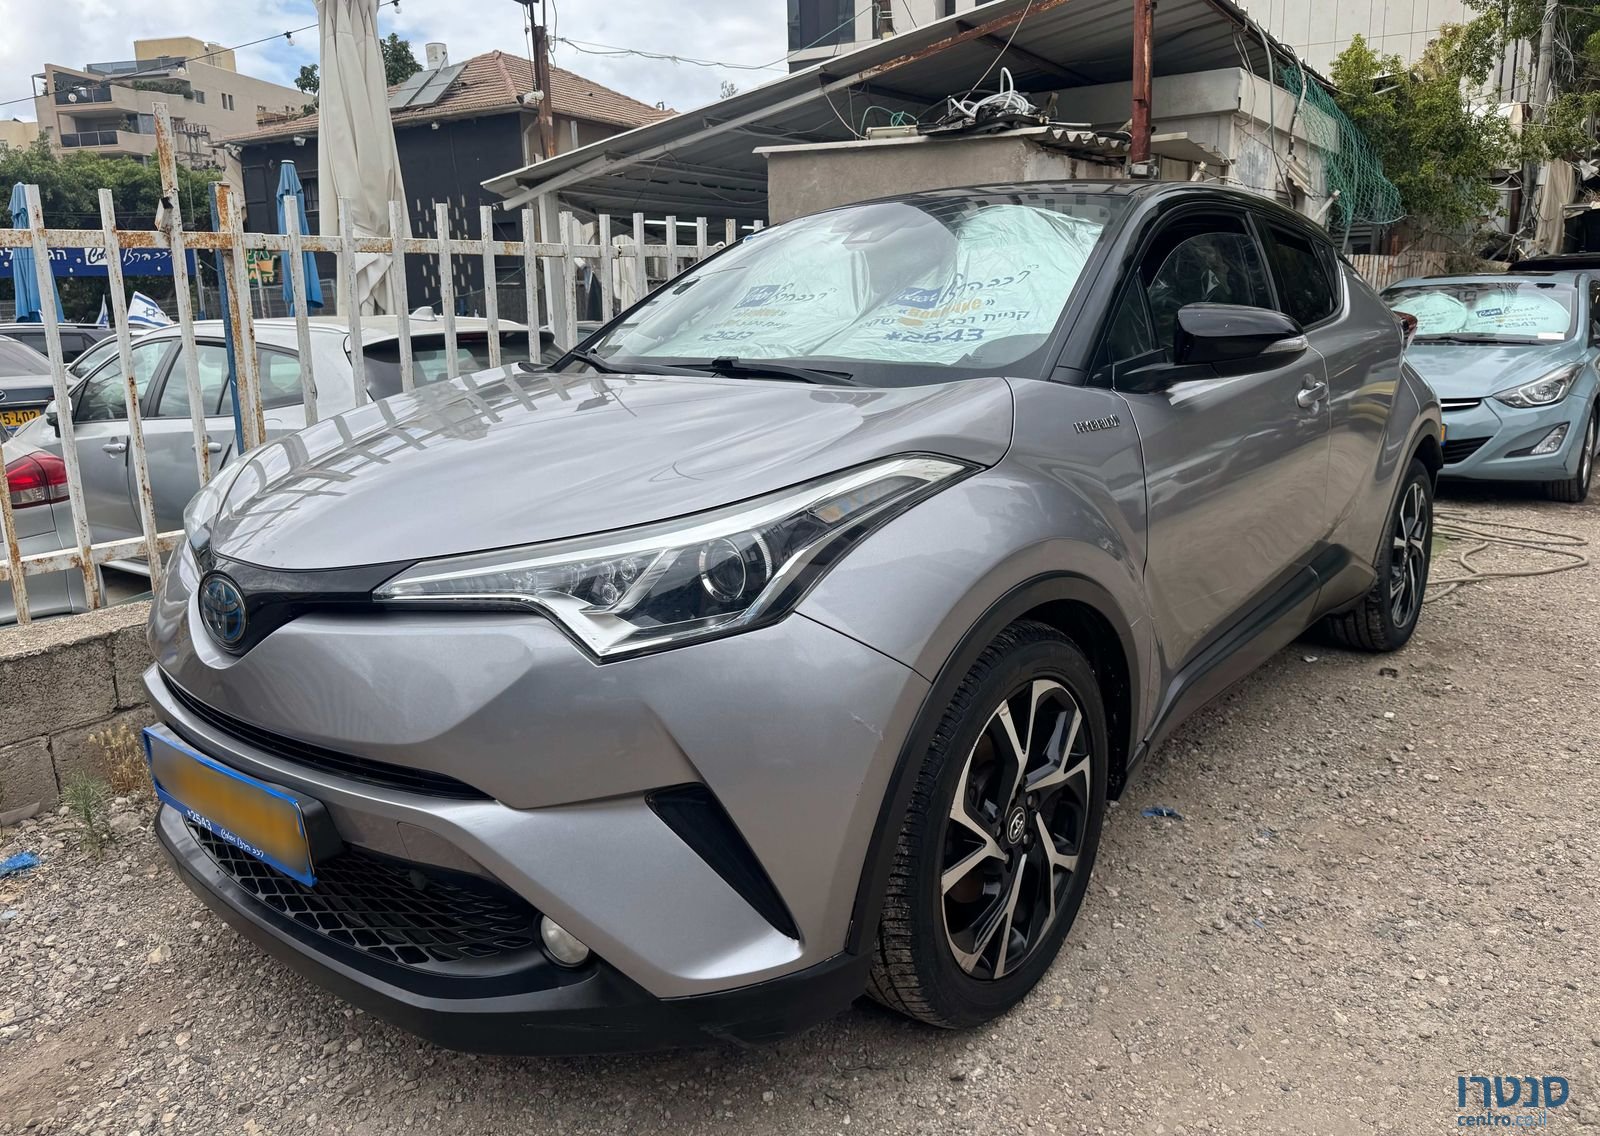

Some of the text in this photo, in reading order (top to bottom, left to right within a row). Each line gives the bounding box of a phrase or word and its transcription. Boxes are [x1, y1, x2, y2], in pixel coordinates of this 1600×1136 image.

[986, 270, 1032, 288] רכב
[938, 272, 984, 307] הרצל
[982, 310, 1033, 322] קניית
[1073, 414, 1121, 434] HYBRID
